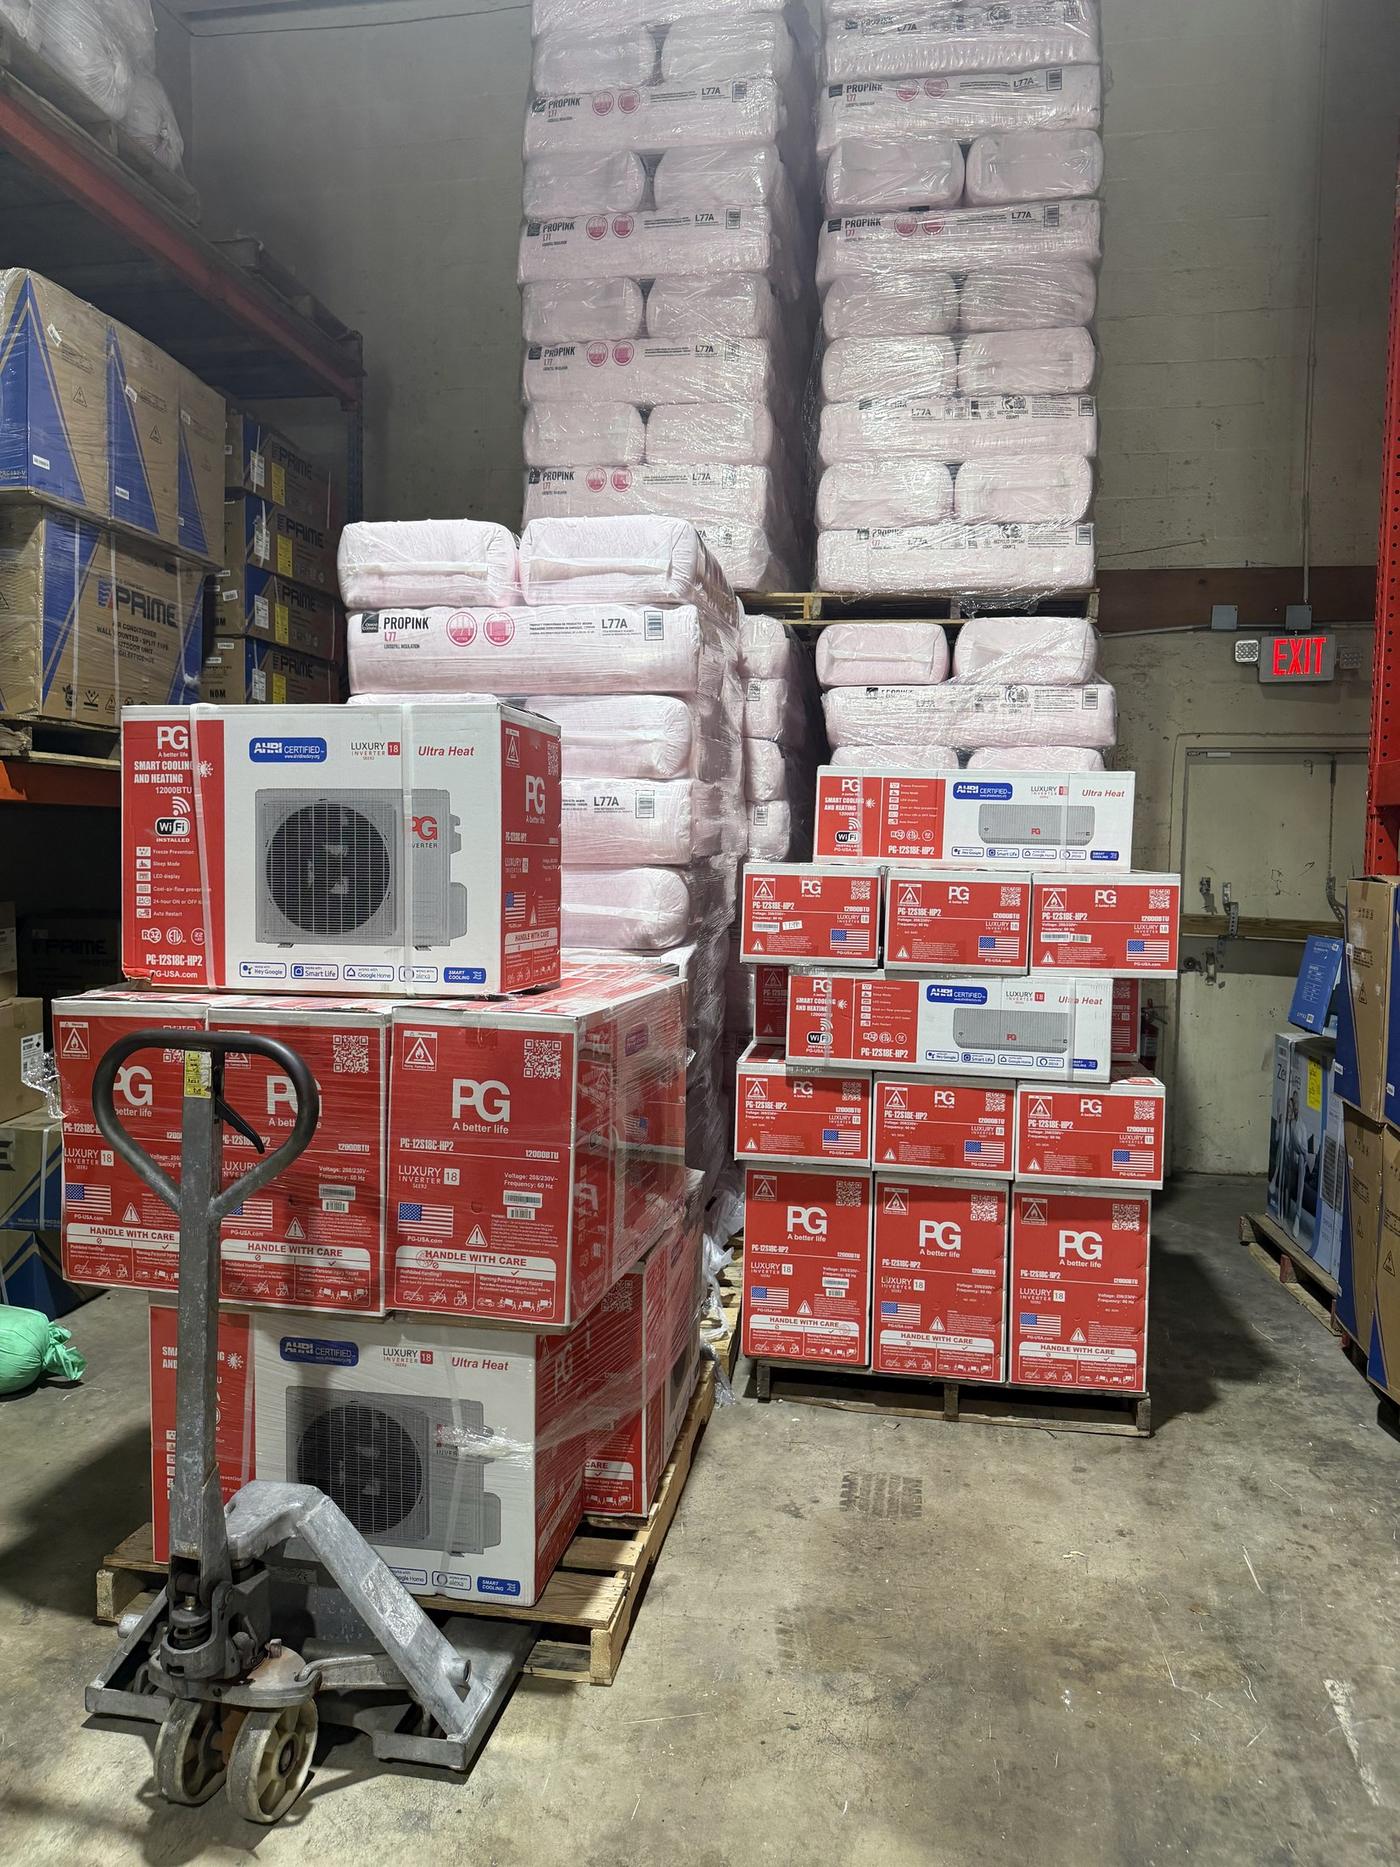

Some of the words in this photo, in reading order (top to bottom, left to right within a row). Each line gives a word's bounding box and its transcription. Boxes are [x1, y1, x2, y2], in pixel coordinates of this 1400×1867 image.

[846, 82, 883, 95] PROPINK
[1013, 76, 1034, 89] L77A
[701, 86, 721, 97] L77A
[548, 97, 581, 110] PROPINK
[695, 213, 715, 223] L77A
[1011, 210, 1032, 221] L77A
[542, 221, 576, 235] PROPINK
[844, 218, 882, 230] PROPINK
[543, 346, 576, 360] PROPINK
[695, 344, 715, 354] L77A
[542, 470, 575, 483] PROPINK
[691, 471, 712, 482] L77A
[285, 515, 324, 548] PRIME
[282, 584, 317, 612] PRIME
[116, 585, 179, 629] PRIME
[383, 616, 430, 630] PROPINK
[602, 618, 628, 629] L77A
[383, 631, 396, 642] L77
[1272, 636, 1328, 677] EXIT
[280, 654, 314, 681] PRIME
[157, 726, 189, 751] PG
[253, 742, 283, 755] AHRI
[283, 744, 320, 755] CERTIFIED
[350, 742, 386, 751] LUXURY
[388, 743, 399, 755] 18
[417, 746, 446, 757] Ultra
[447, 746, 476, 757] Heat
[134, 760, 160, 771] SMART
[134, 774, 150, 784] AND
[150, 774, 183, 784] HEATING
[155, 787, 193, 795] 12000BTU
[525, 774, 546, 816] PG
[979, 787, 1009, 796] CERTIFIED
[1030, 785, 1058, 793] LUXURY
[1081, 788, 1103, 799] Ultra
[1104, 788, 1126, 800] Heat
[593, 796, 620, 807] L77A
[887, 844, 935, 857] PG-12S18E-HP2
[800, 879, 822, 895] PG
[948, 885, 970, 902] PG
[1094, 888, 1117, 906] PG
[752, 900, 795, 912] PG-12S18E-HP2
[897, 906, 942, 918] PG-12S18E-HP2
[1041, 912, 1089, 922] PG-12S18E-HP2
[514, 932, 530, 943] HANDLE
[530, 930, 541, 941] WITH
[145, 954, 204, 967] PG-12S18C-HP2
[264, 968, 283, 978] Google
[304, 969, 324, 978] Smart
[324, 970, 337, 979] Life
[356, 971, 376, 981] Google
[376, 972, 392, 980] Home
[796, 997, 813, 1005] SMART
[954, 991, 984, 1001] CERTIFIED
[1005, 991, 1034, 999] LUXURY
[1081, 997, 1104, 1007] Heat
[860, 1046, 909, 1060] PG-12S18E-HP2
[793, 1080, 813, 1096] PG
[451, 1077, 512, 1124] PG
[934, 1090, 956, 1106] PG
[745, 1100, 788, 1112] PG-12S18E-HP2
[1080, 1098, 1103, 1115] PG
[139, 1107, 153, 1118] life
[884, 1109, 929, 1121] PG-12S18E-HP2
[452, 1121, 460, 1132] A
[461, 1122, 492, 1133] better
[493, 1123, 510, 1135] life
[1027, 1119, 1074, 1131] PG-12S18E-HP2
[63, 1148, 99, 1159] LUXURY
[399, 1137, 455, 1152] PG-12S18C-HP2
[525, 1149, 560, 1160] 12000BTU
[64, 1158, 99, 1166] INVERTER
[398, 1165, 442, 1178] LUXURY
[445, 1168, 460, 1186] 18
[398, 1175, 442, 1185] INVERTER
[504, 1171, 528, 1181] Voltage:
[503, 1179, 536, 1190] Frequency:
[537, 1181, 545, 1189] 60
[546, 1182, 554, 1190] Hz
[74, 1213, 105, 1222] PG-USA.com
[786, 1205, 828, 1236] PG
[89, 1226, 125, 1238] HANDLE
[126, 1229, 150, 1241] WITH
[150, 1231, 176, 1242] CARE
[230, 1229, 264, 1238] PG-USA.com
[407, 1234, 444, 1245] PG-USA.com
[794, 1234, 814, 1242] better
[815, 1235, 827, 1243] life
[918, 1219, 962, 1251] PG
[247, 1242, 287, 1254] HANDLE
[287, 1244, 315, 1256] WITH
[316, 1246, 344, 1258] CARE
[1057, 1229, 1103, 1261] PG
[424, 1249, 467, 1262] HANDLE
[468, 1252, 497, 1264] WITH
[498, 1255, 528, 1267] CARE
[919, 1248, 926, 1256] A
[926, 1249, 948, 1258] better
[948, 1250, 961, 1259] life
[751, 1262, 781, 1270] LUXURY
[1059, 1258, 1066, 1267] A
[1066, 1259, 1089, 1268] better
[1089, 1260, 1102, 1270] life
[880, 1276, 913, 1286] LUXURY
[1019, 1287, 1053, 1298] LUXURY
[769, 1316, 799, 1325] HANDLE
[799, 1318, 820, 1328] WITH
[820, 1320, 840, 1329] CARE
[900, 1332, 930, 1342] HANDLE
[931, 1334, 952, 1344] WITH
[953, 1336, 974, 1345] CARE
[314, 1348, 352, 1359] CERTIFIED
[382, 1347, 419, 1359] LUXURY
[1039, 1343, 1072, 1354] HANDLE
[1072, 1345, 1094, 1355] WITH
[1094, 1347, 1116, 1357] CARE
[451, 1356, 480, 1370] Ultra
[481, 1360, 510, 1373] Heat
[584, 1461, 610, 1471] CARE
